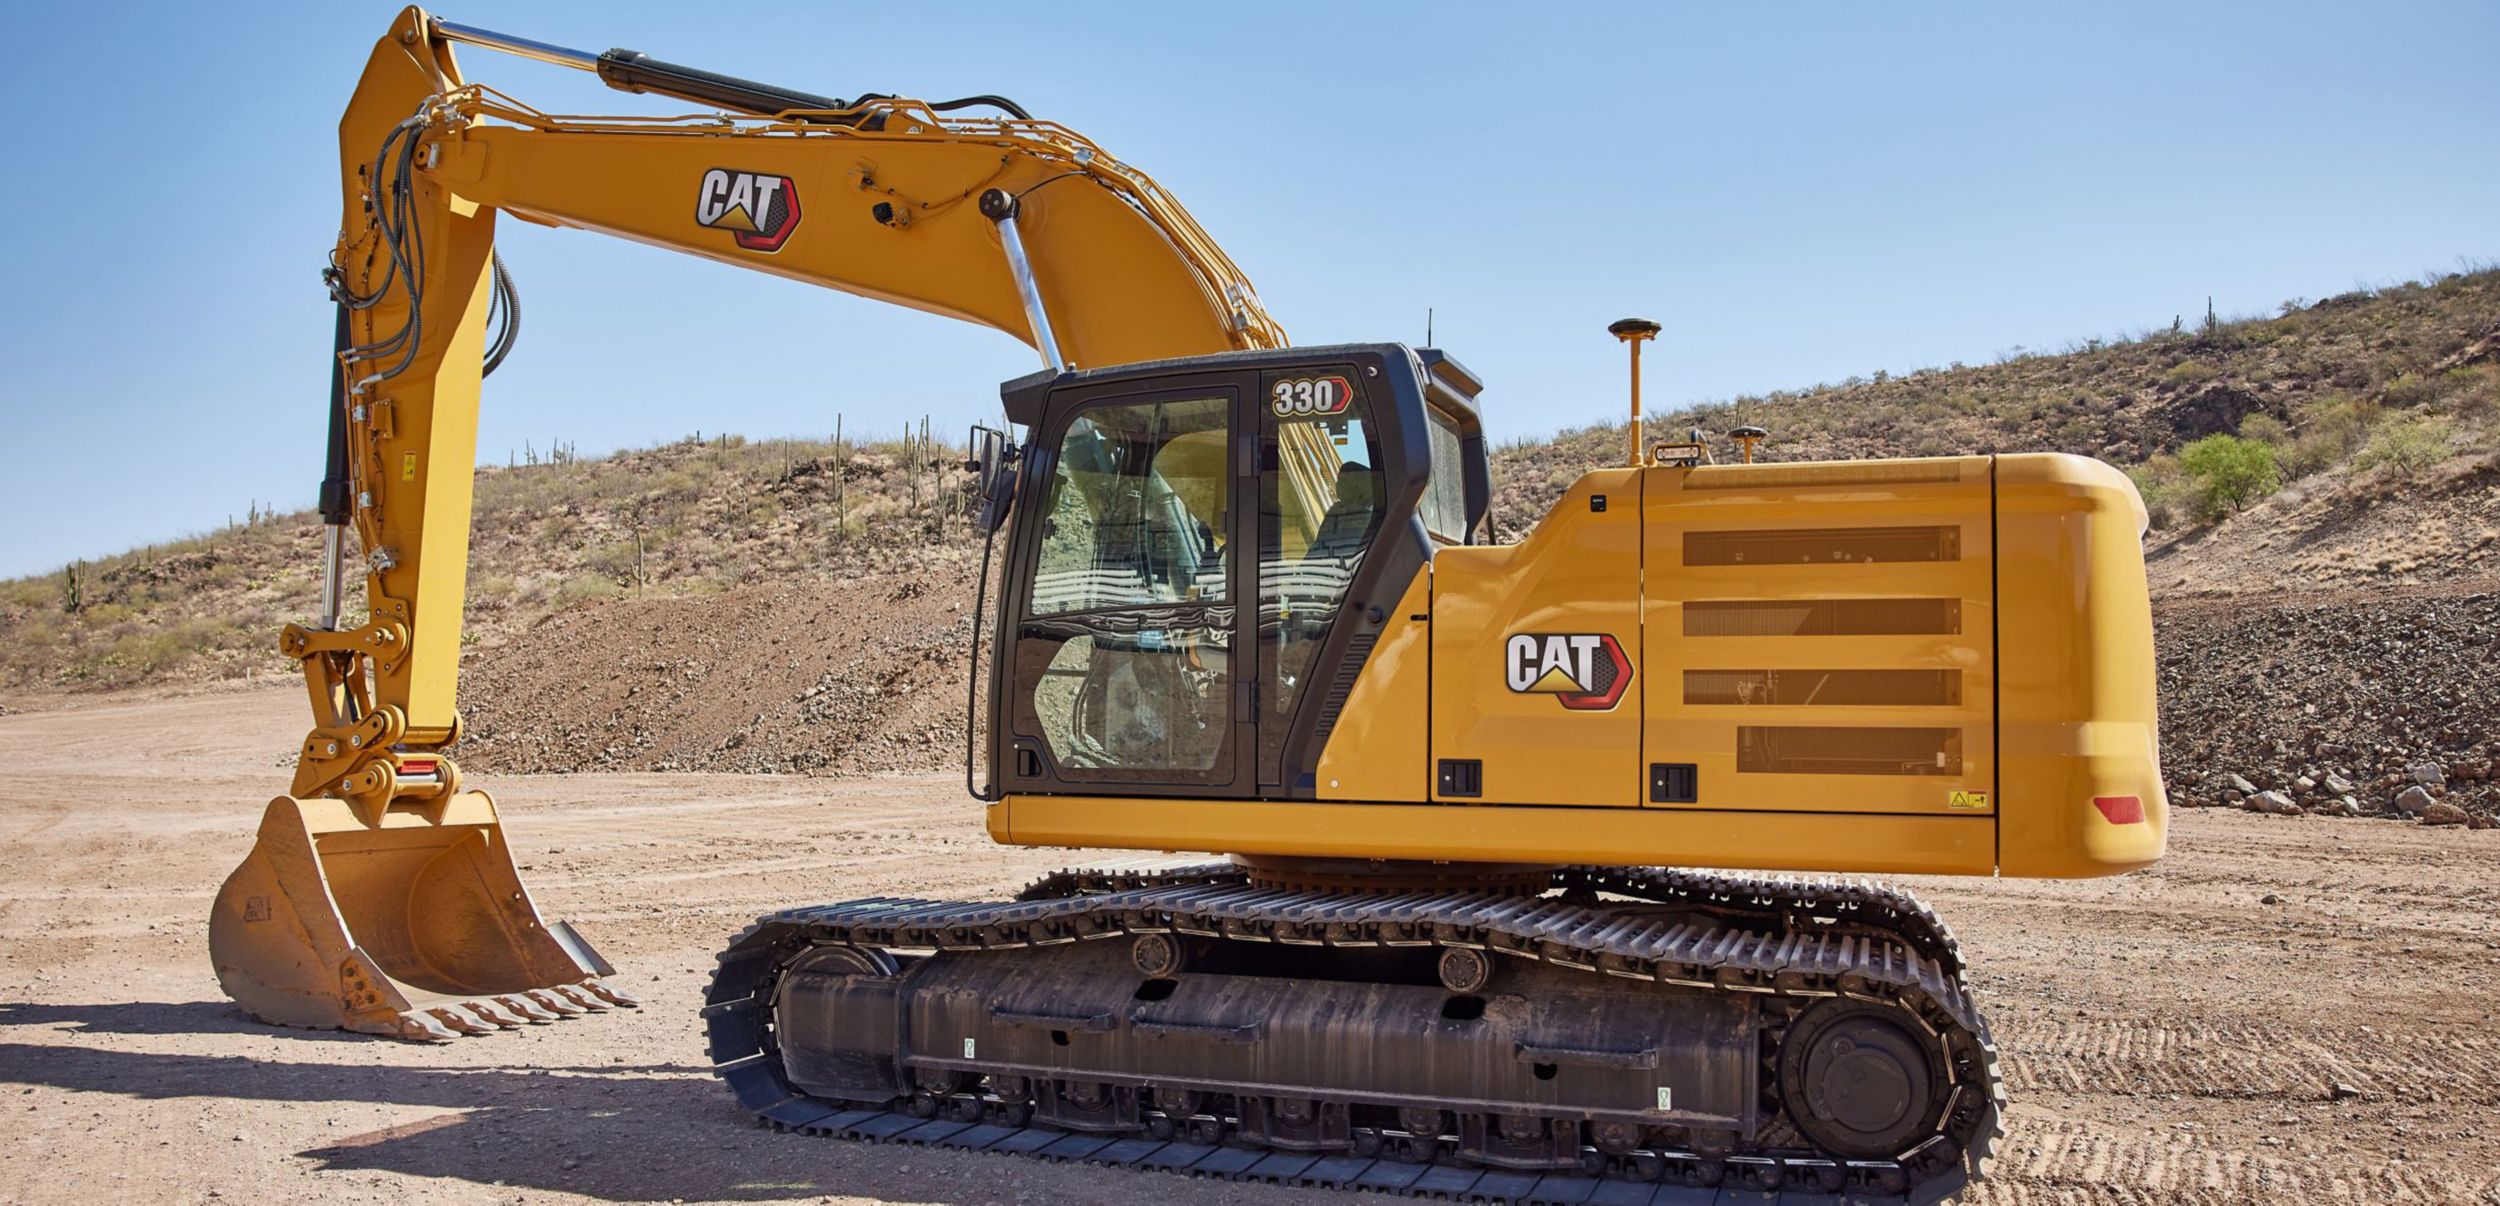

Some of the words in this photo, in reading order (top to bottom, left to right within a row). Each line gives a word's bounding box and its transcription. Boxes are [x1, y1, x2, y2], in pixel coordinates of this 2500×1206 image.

[697, 169, 782, 232] CAT
[1275, 380, 1333, 414] 330
[1507, 634, 1601, 692] CAT
